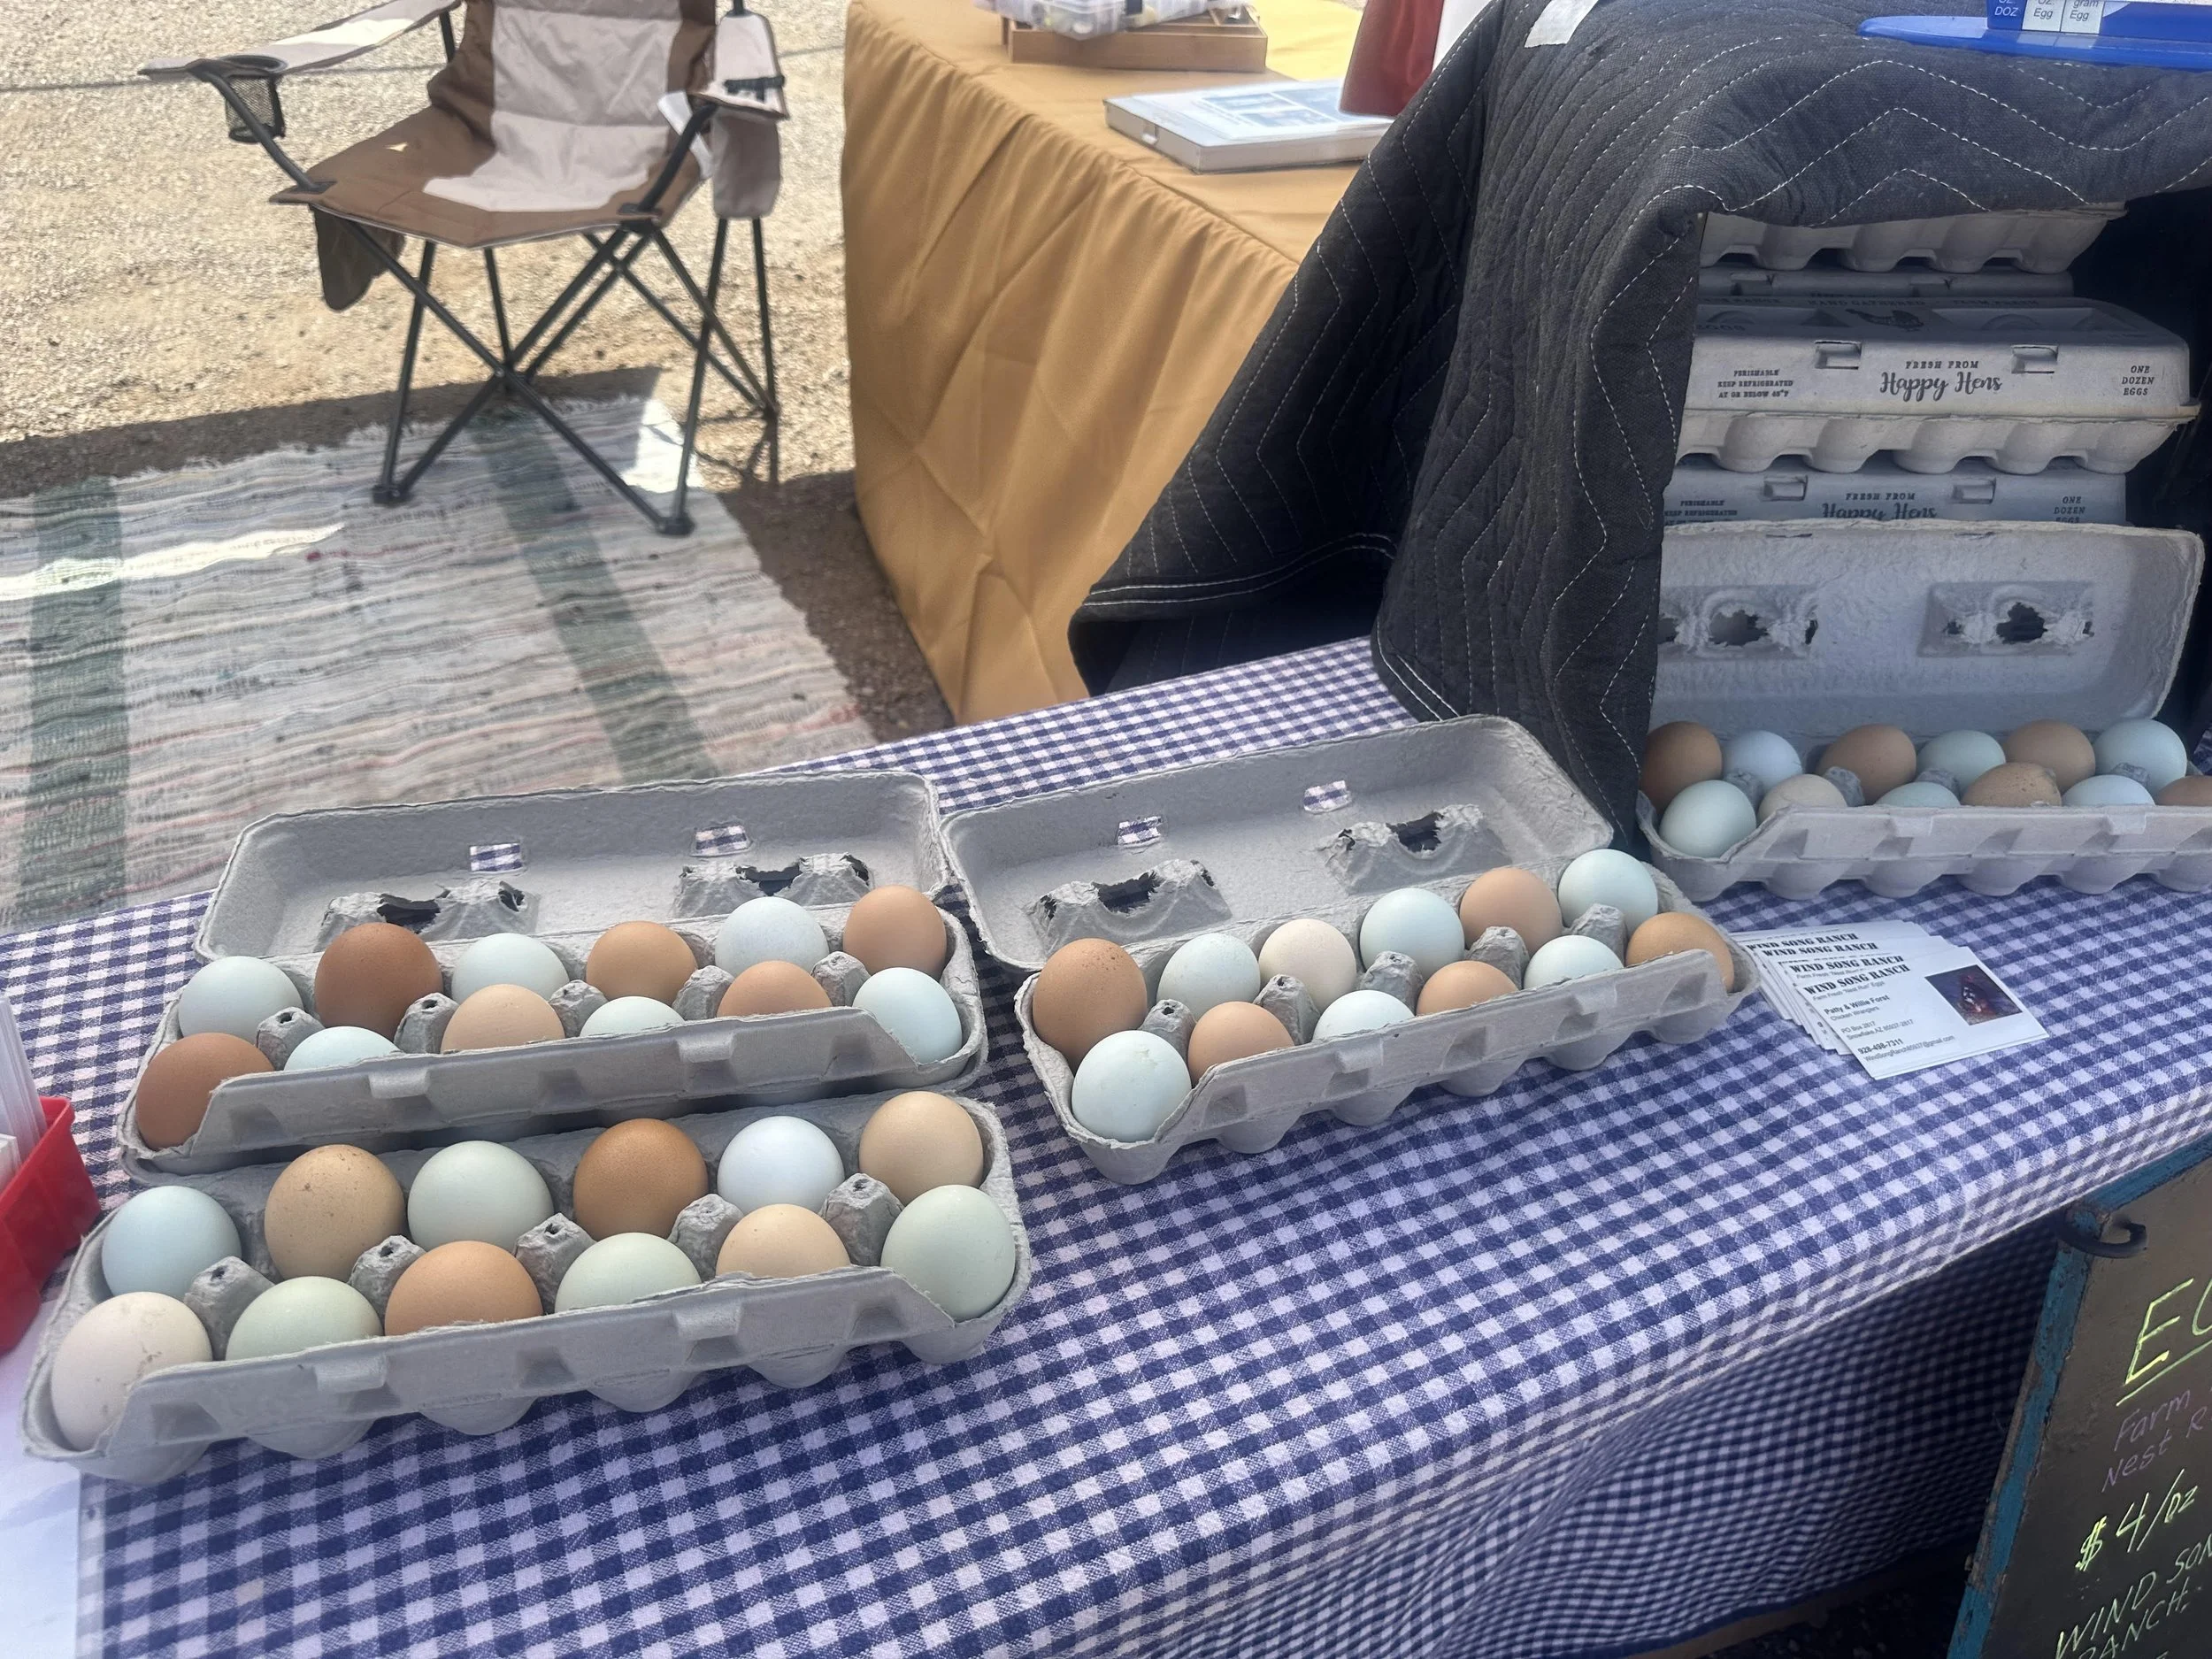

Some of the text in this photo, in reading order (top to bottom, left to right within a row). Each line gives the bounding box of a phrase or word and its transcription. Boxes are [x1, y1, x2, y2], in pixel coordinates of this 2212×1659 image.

[1994, 6, 2019, 17] DOZ
[2033, 7, 2054, 20] Egg
[2070, 10, 2090, 22] Egg
[1905, 360, 1979, 369] FRESH FROM
[2130, 365, 2151, 374] ONE
[1879, 371, 2003, 403] Happy Hens
[2121, 376, 2155, 385] DOZEN
[2123, 387, 2149, 396] EGGS
[1845, 492, 1916, 501] FRESH FROM
[2062, 495, 2082, 504] ONE
[2053, 506, 2086, 515] DOZEN
[1781, 937, 1815, 947] SONG
[1815, 933, 1859, 944] RANCH
[1798, 945, 1832, 955] SONG
[1833, 942, 1879, 952] RANCH
[1789, 963, 1824, 973] WIND
[1825, 958, 1860, 970] SONG
[1860, 955, 1905, 966] RANCH
[1803, 981, 1837, 995] WIND
[1837, 973, 1870, 987] SONG
[1869, 964, 1911, 979] RANCH
[1824, 1005, 1843, 1015] Patty
[1849, 1000, 1870, 1009] Willie
[1870, 995, 1890, 1003] Forst
[2113, 1389, 2191, 1452] Farm
[2101, 1428, 2173, 1494] Nest
[2055, 1571, 2157, 1659] WIND
